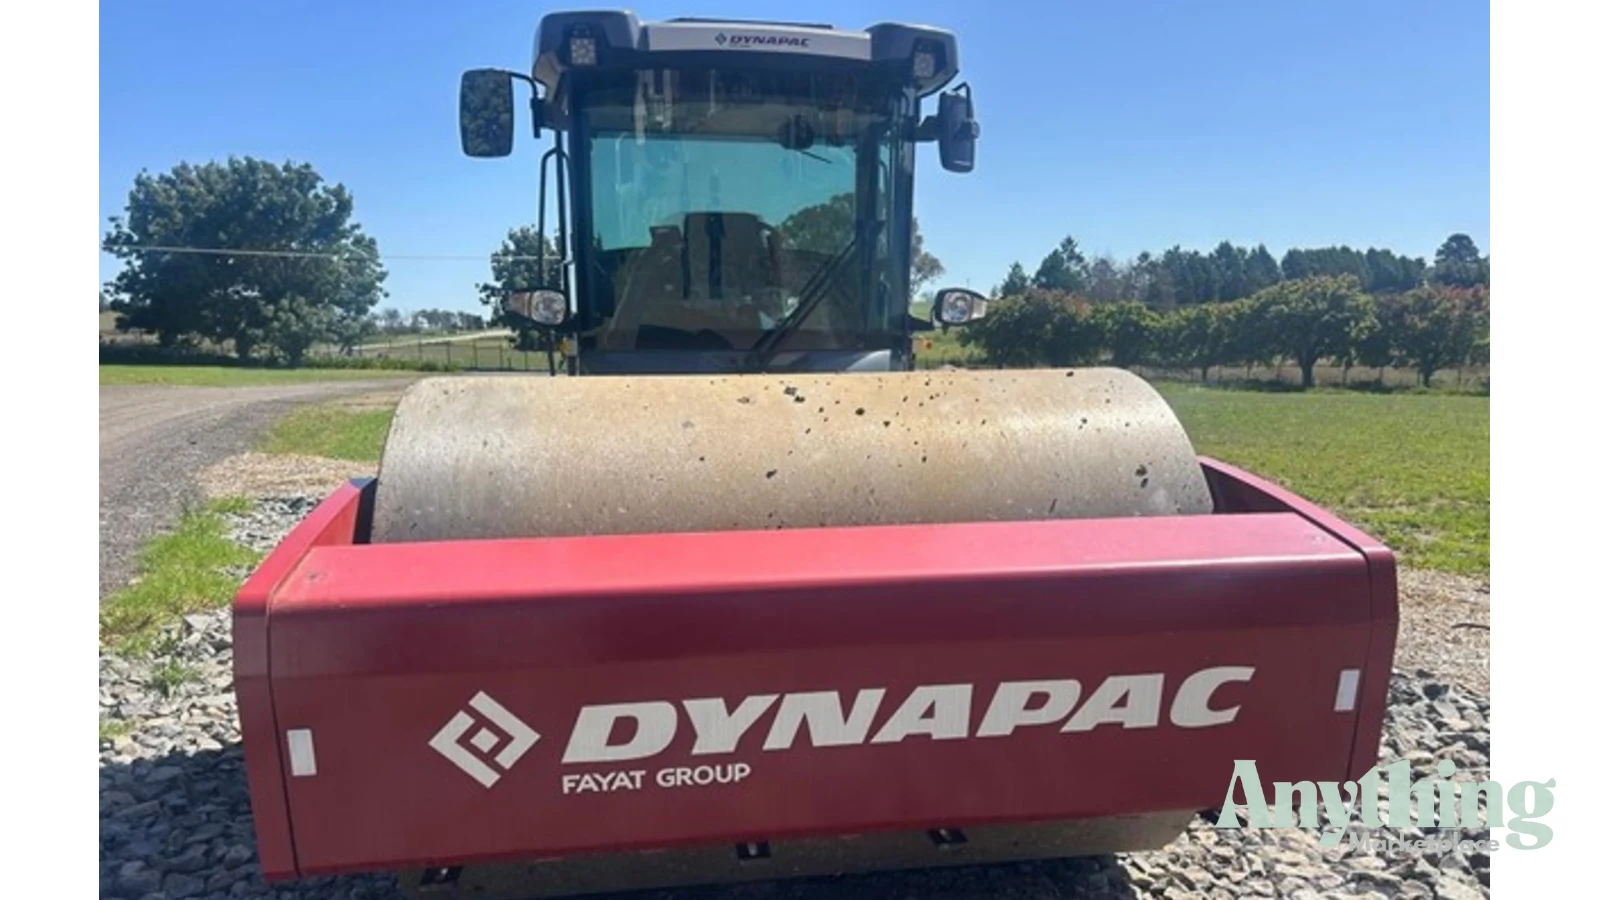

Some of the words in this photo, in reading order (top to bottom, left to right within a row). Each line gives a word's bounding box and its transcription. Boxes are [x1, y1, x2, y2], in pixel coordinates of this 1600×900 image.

[729, 35, 810, 48] DYNAPAC
[562, 666, 1255, 763] DYNAPAC
[562, 770, 646, 794] FAYAT
[656, 763, 751, 787] GROUP
